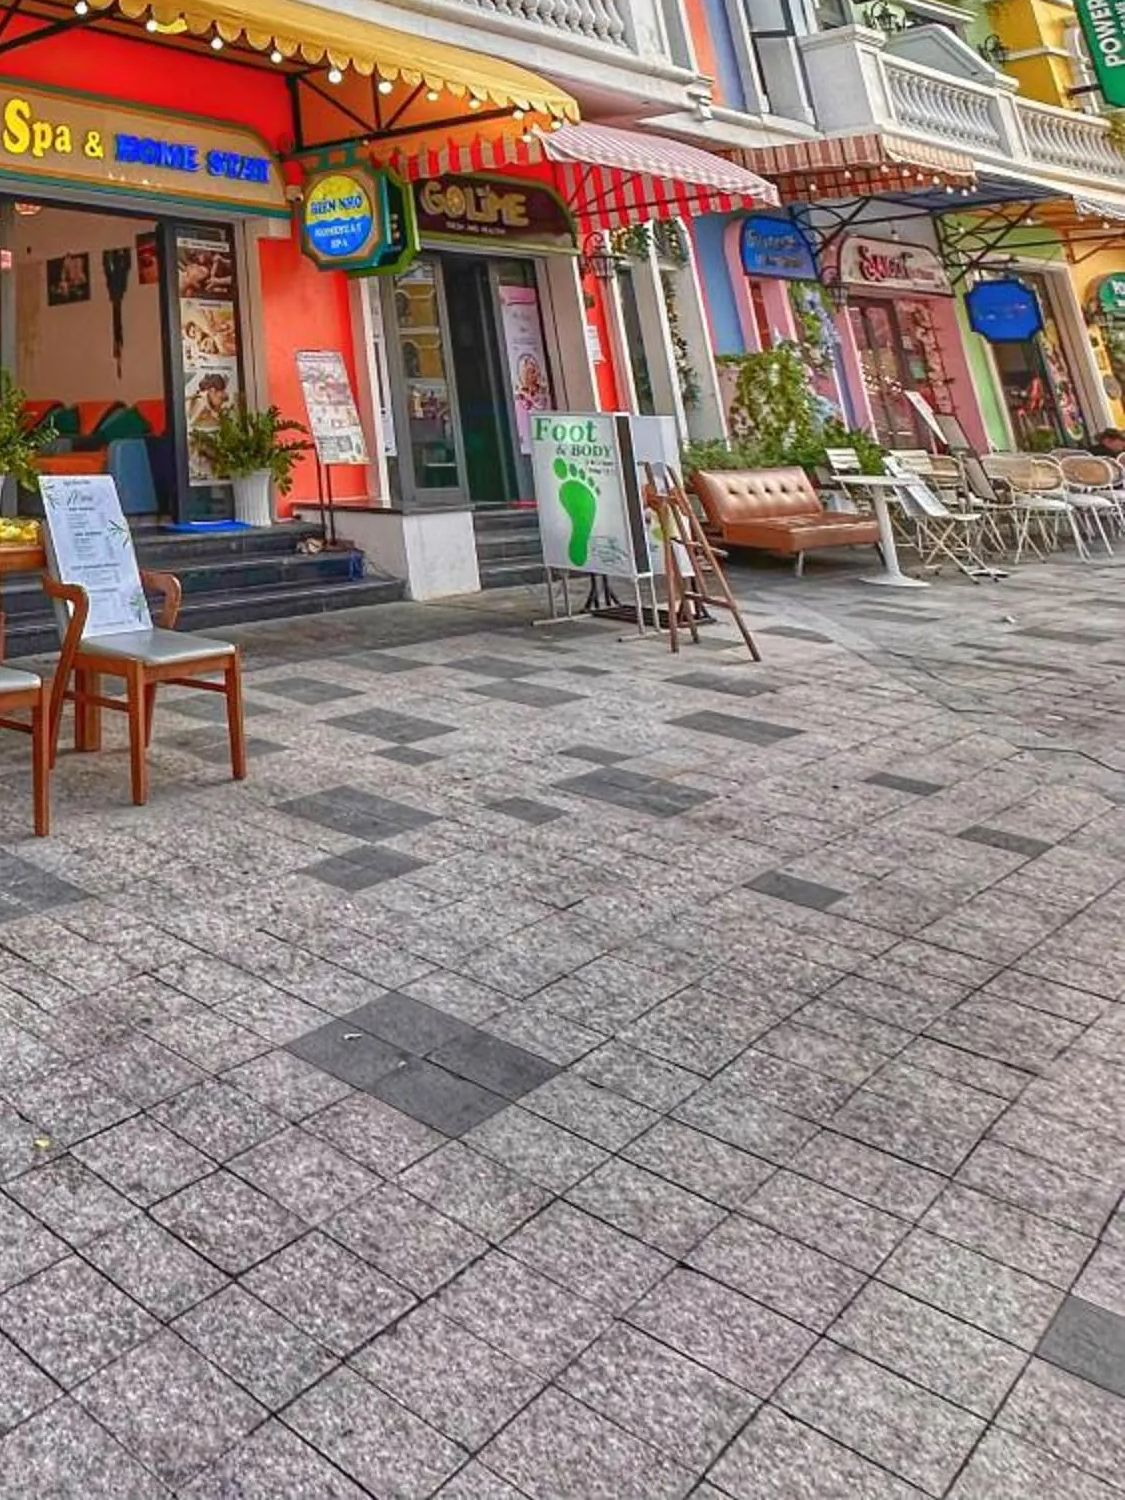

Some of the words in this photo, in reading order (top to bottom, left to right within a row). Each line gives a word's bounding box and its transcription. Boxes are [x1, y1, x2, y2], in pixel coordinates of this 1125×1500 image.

[2, 98, 72, 157] Spa
[84, 131, 104, 159] &
[114, 132, 200, 172] HOME
[534, 417, 598, 442] Foot
[555, 444, 566, 456] &
[570, 443, 613, 458] BODY
